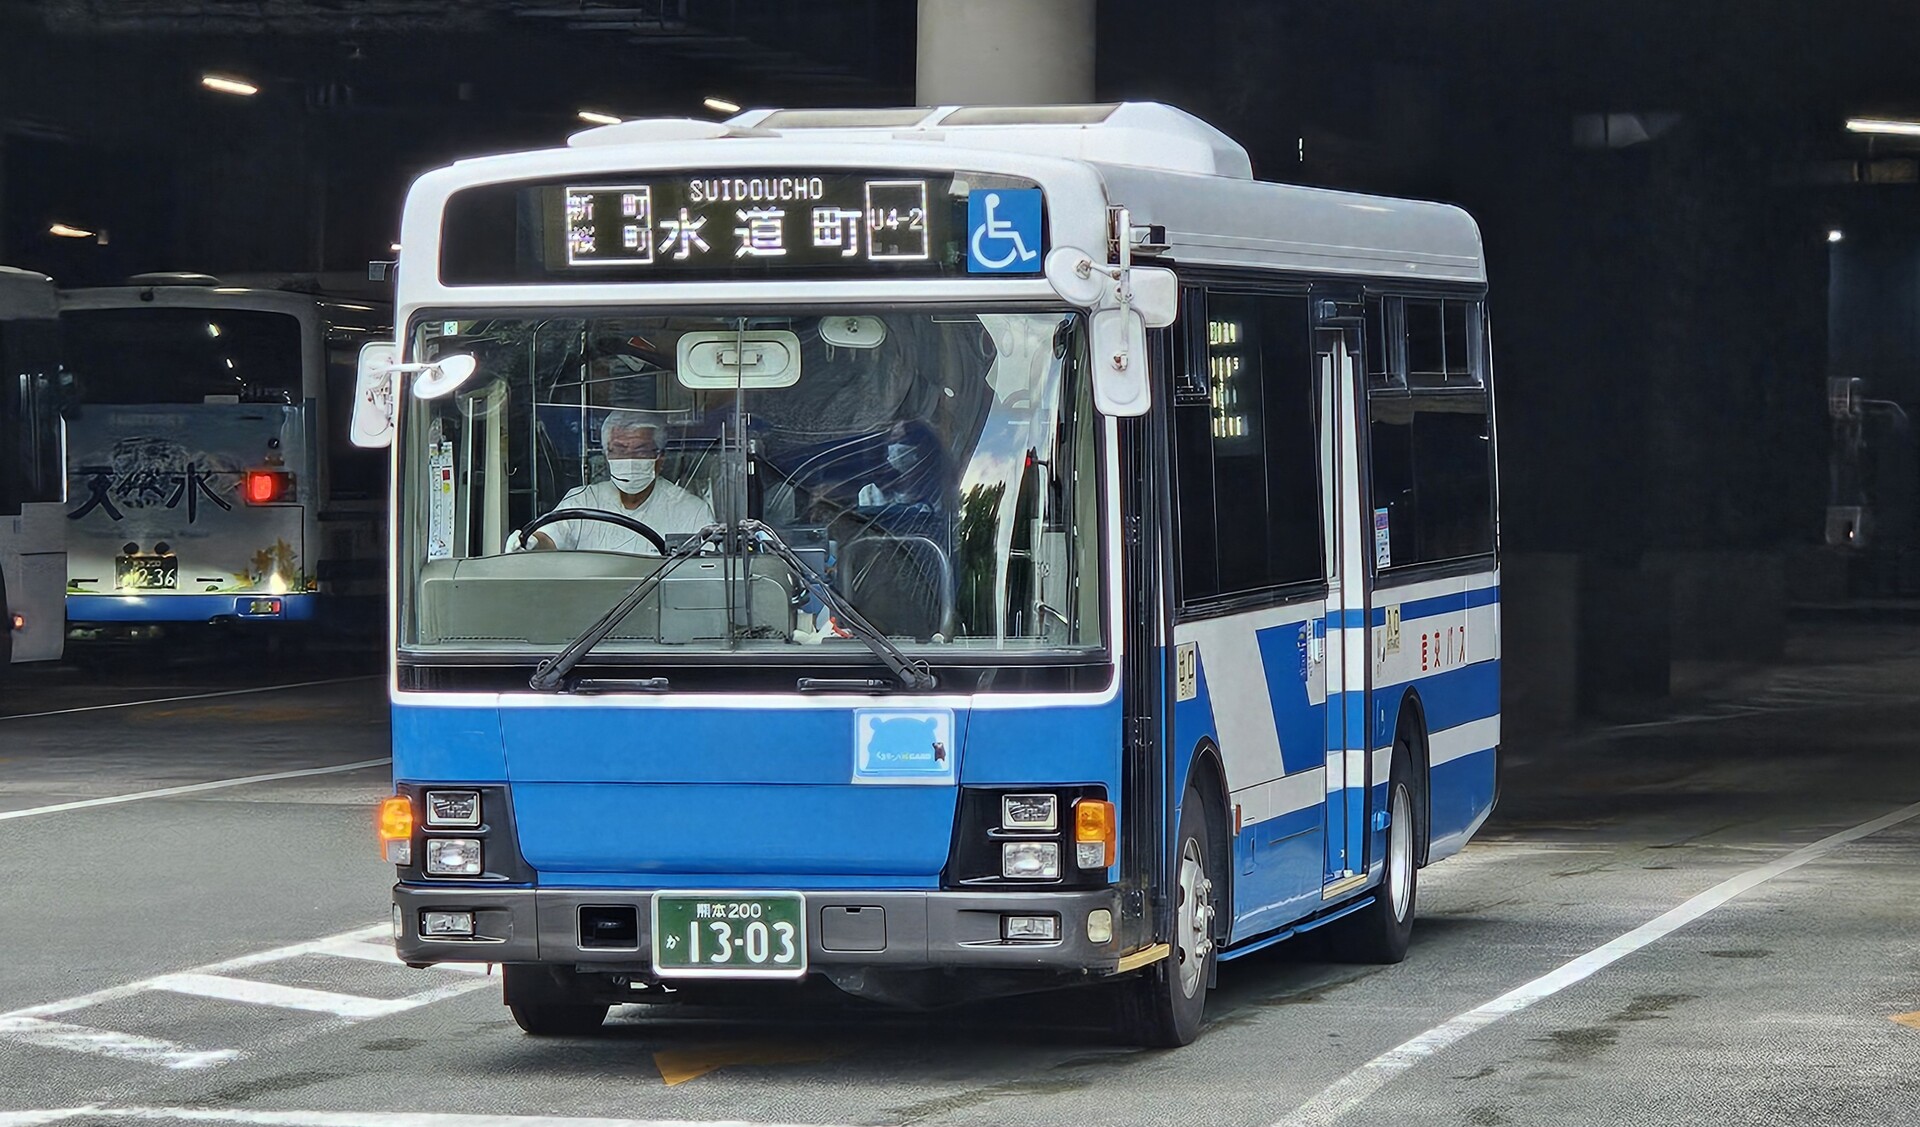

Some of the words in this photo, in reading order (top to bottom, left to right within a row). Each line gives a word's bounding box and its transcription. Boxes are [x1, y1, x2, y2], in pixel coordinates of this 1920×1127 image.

[690, 177, 823, 201] SUIDOUCHO
[658, 206, 863, 260] 水道町
[870, 207, 923, 232] U4-2
[665, 934, 681, 950] か
[690, 921, 795, 963] 13-03
